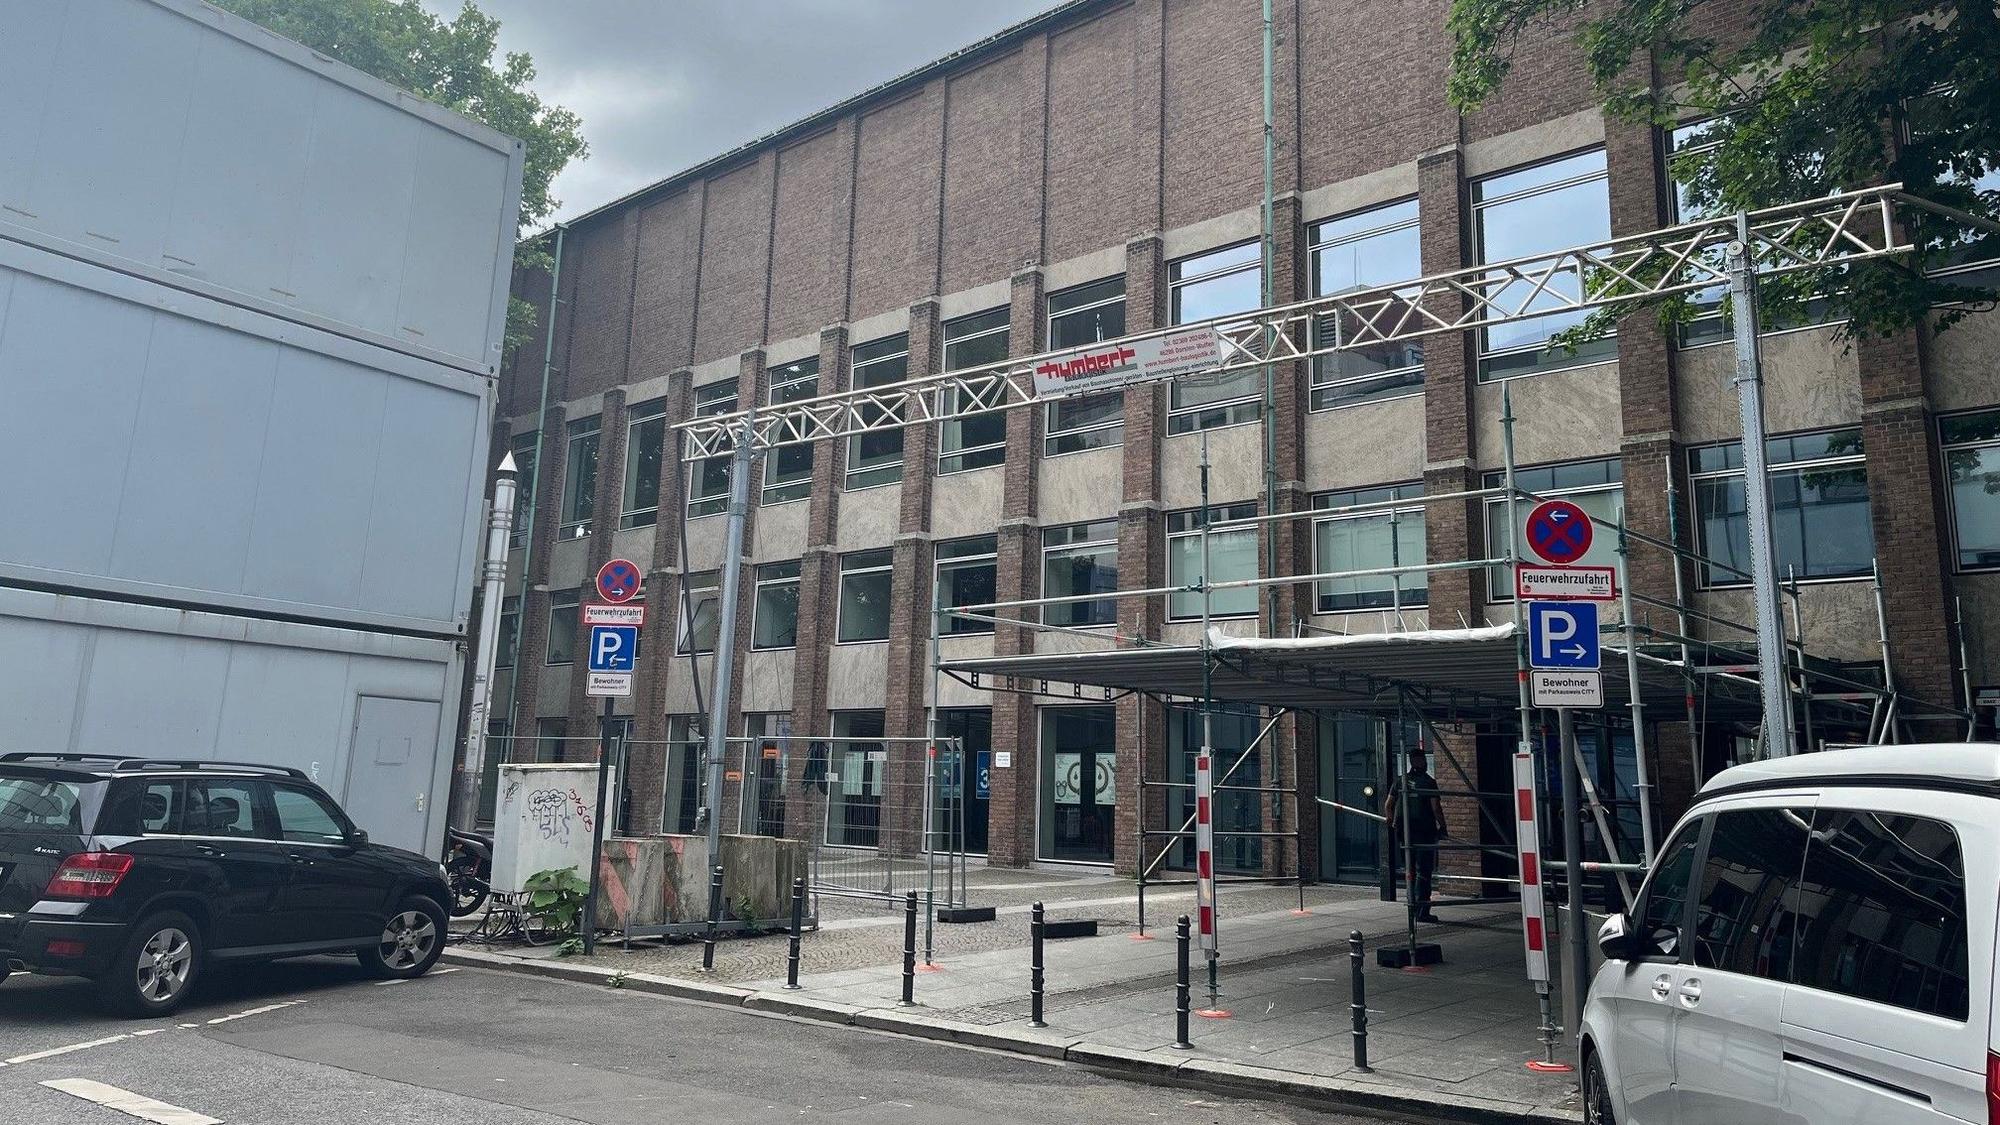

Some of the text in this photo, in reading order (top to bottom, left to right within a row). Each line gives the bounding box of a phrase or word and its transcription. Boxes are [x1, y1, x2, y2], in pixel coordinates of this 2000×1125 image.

[1036, 347, 1136, 379] humbert
[1522, 571, 1609, 585] Feuerwehrzufahrt
[586, 607, 642, 617] Feuerwehrzufahrt
[1540, 610, 1577, 659] P
[596, 632, 622, 665] P
[594, 677, 624, 685] Bewohner
[1542, 678, 1589, 687] Bewohner
[1547, 688, 1580, 696] Parkausweis
